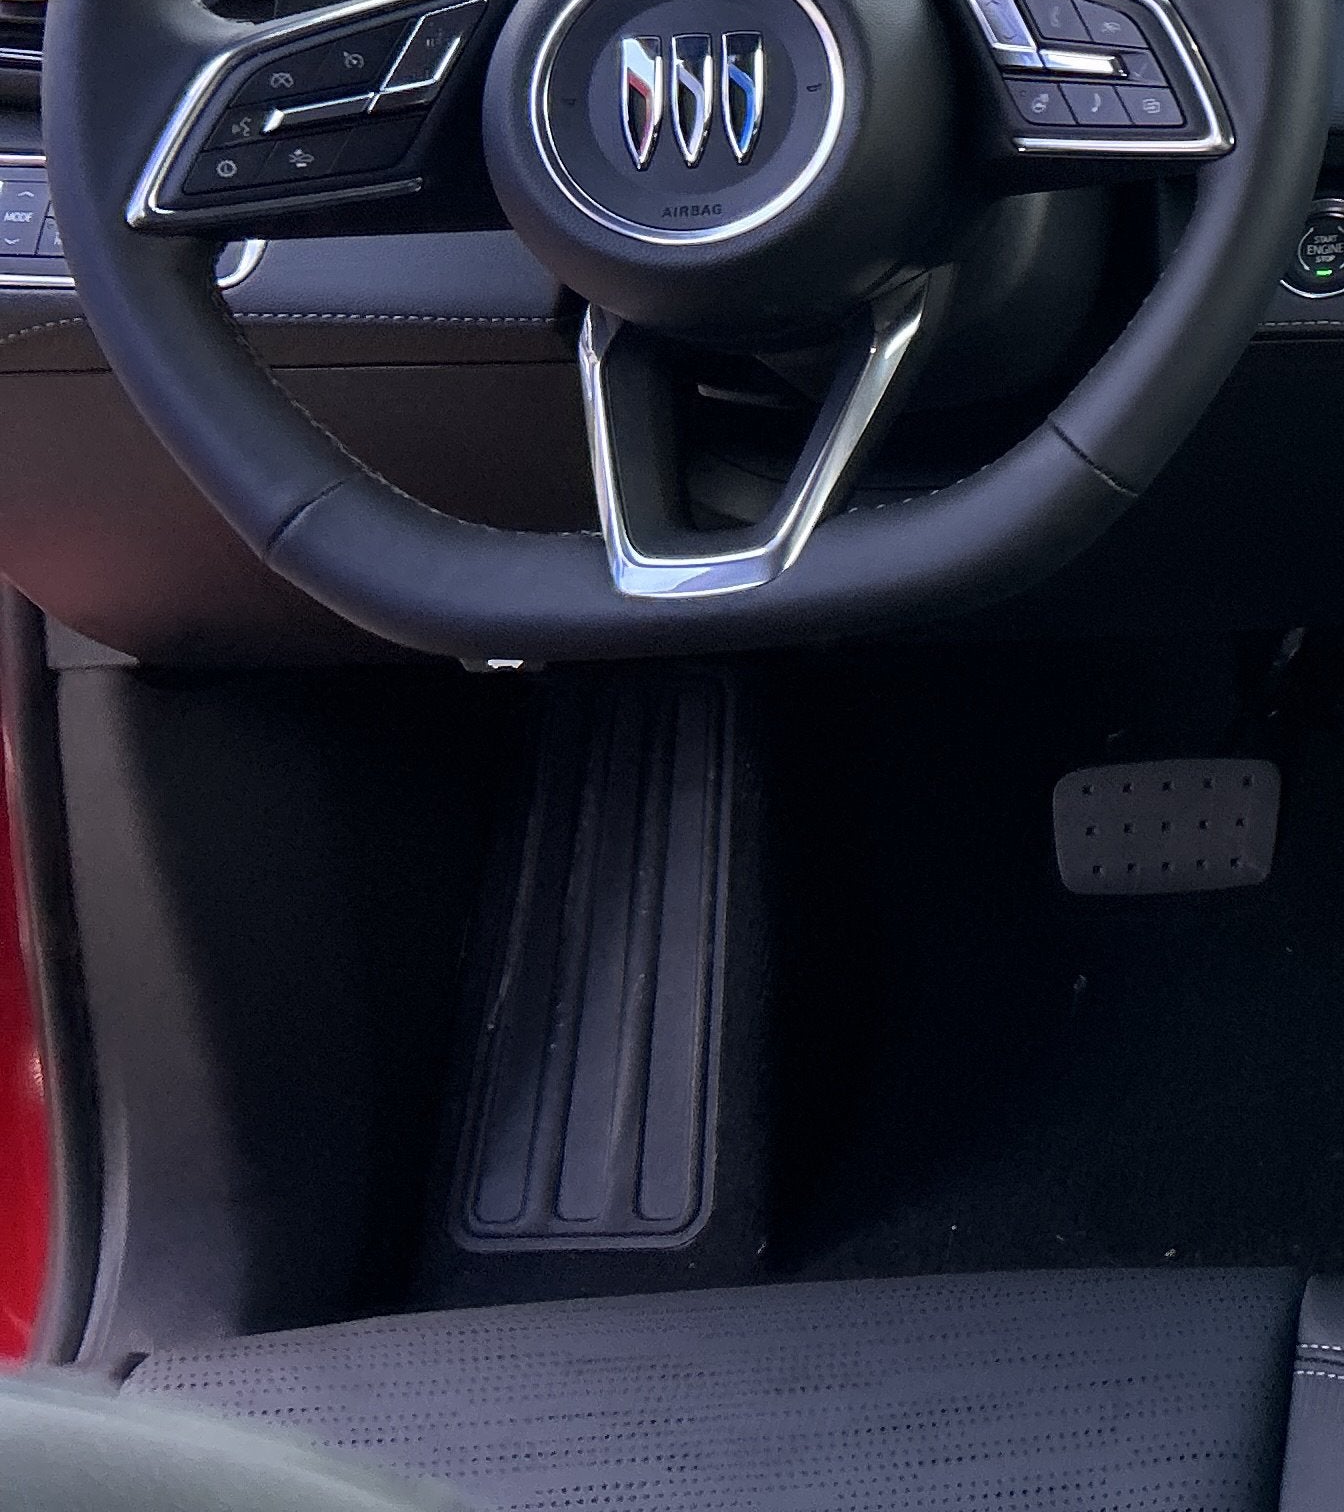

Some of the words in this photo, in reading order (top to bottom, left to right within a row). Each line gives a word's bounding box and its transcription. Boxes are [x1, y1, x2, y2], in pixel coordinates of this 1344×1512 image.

[661, 204, 722, 218] AIRBAG
[4, 212, 34, 223] MODE
[1314, 234, 1339, 244] START
[1306, 242, 1344, 255] ENGINE
[1315, 255, 1336, 264] STOP
